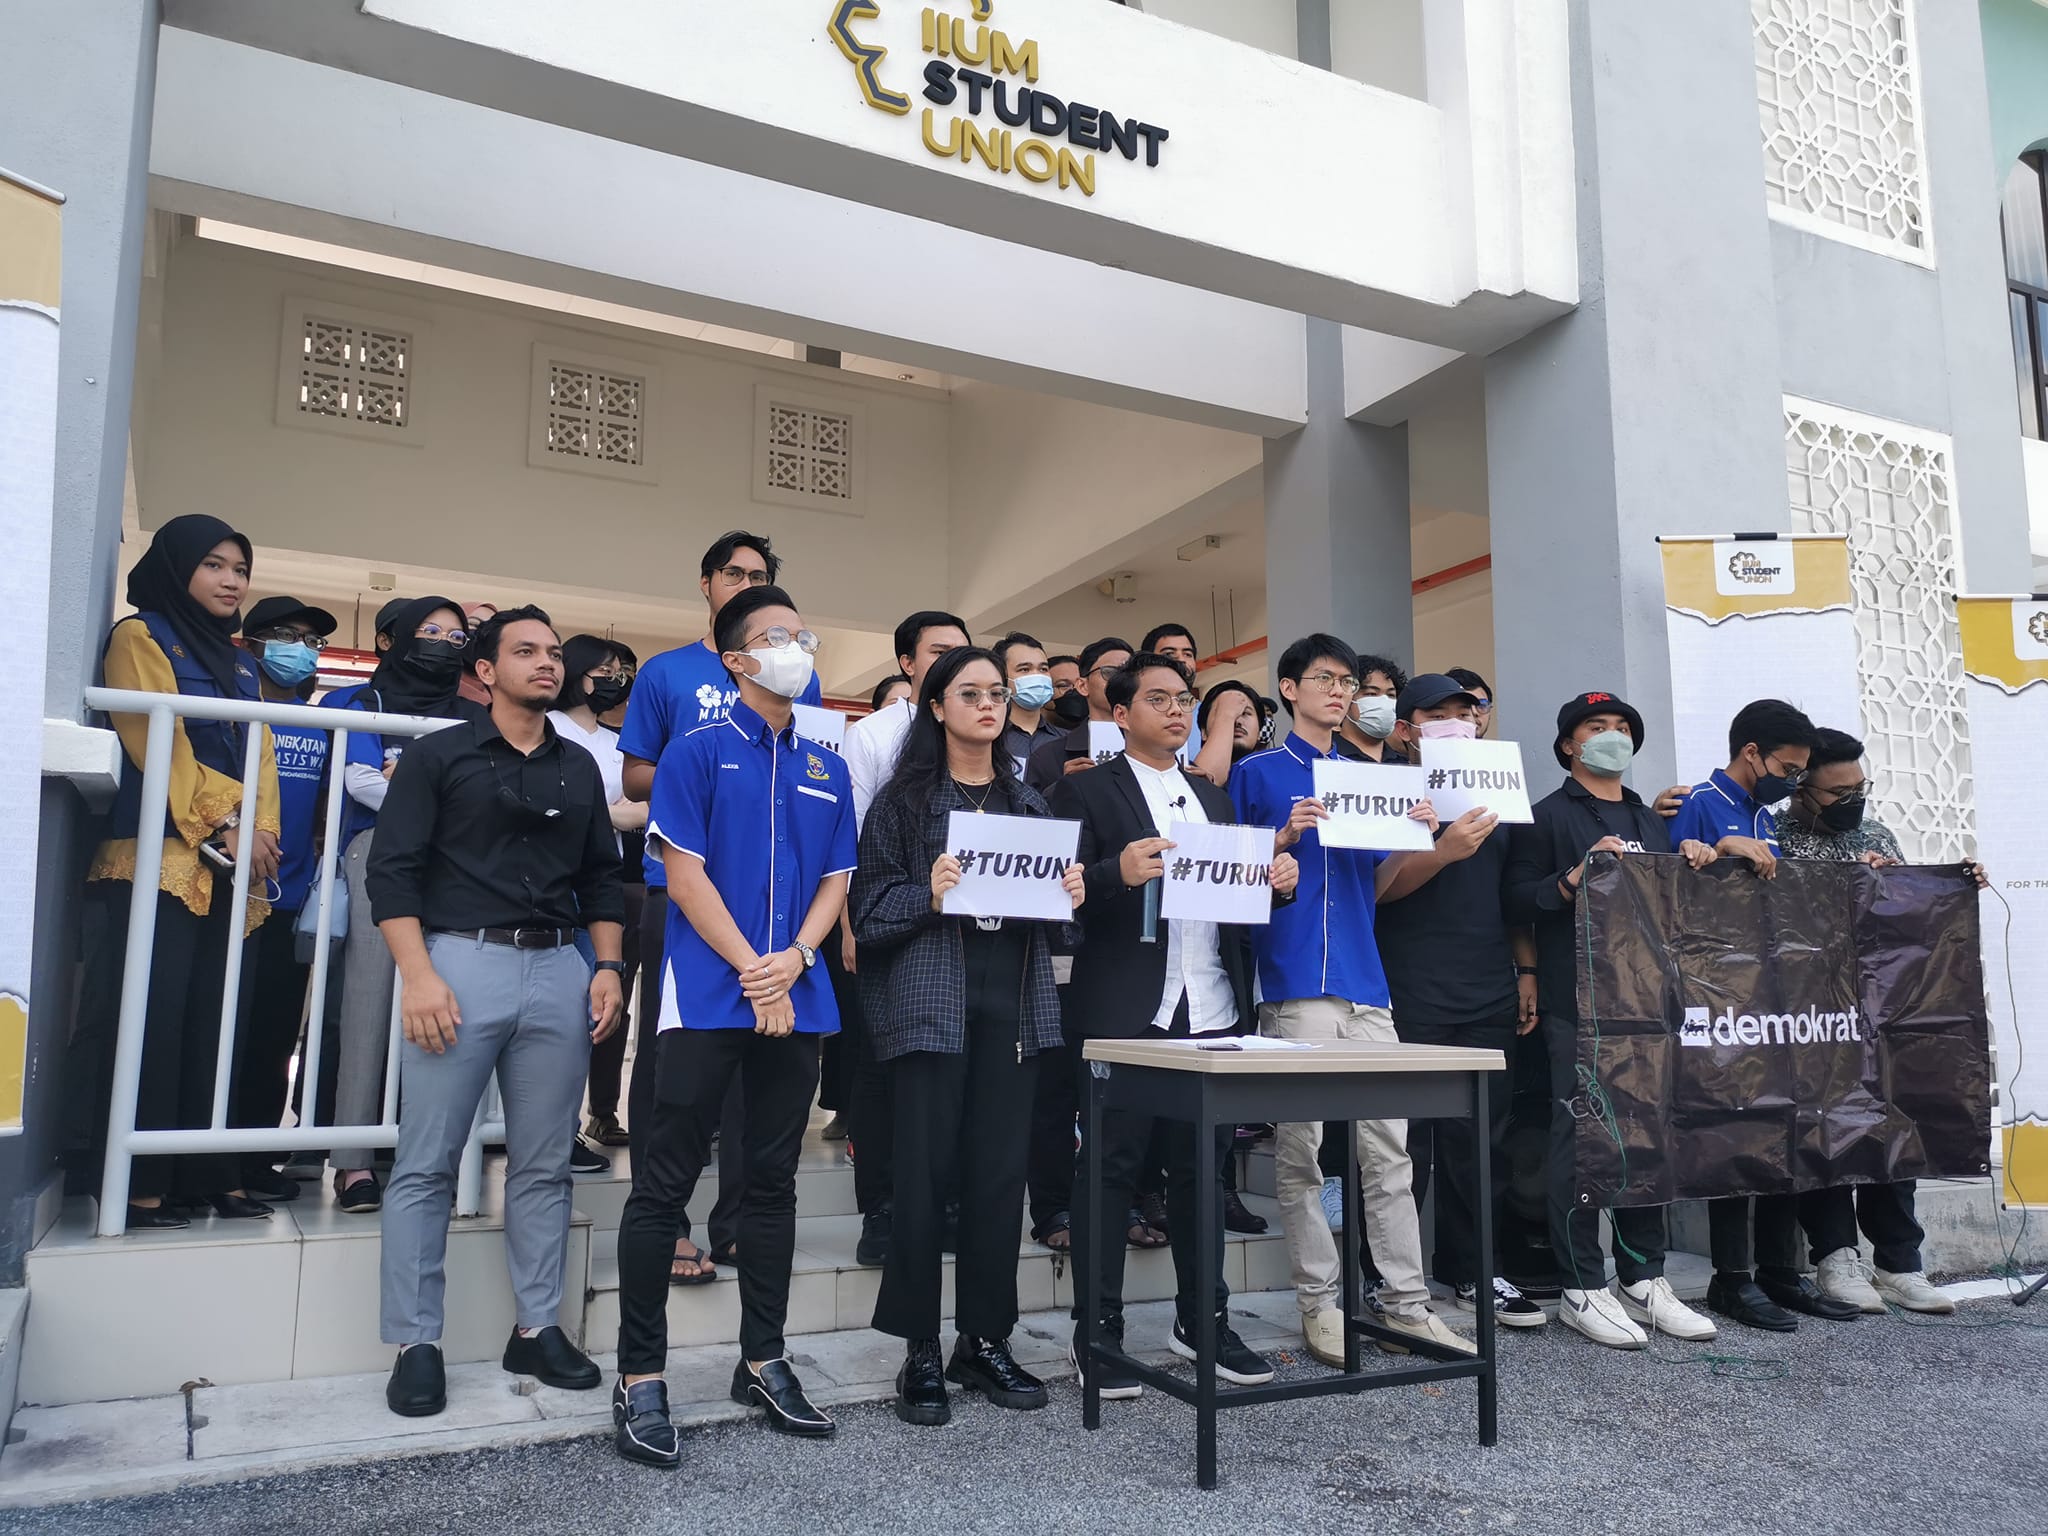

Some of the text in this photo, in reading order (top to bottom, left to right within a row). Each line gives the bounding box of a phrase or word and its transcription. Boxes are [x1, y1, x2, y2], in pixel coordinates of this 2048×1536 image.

[921, 8, 1039, 83] IIUM
[922, 60, 1170, 167] STUDENT
[921, 107, 1096, 197] UNION
[1742, 567, 1781, 576] STUDENT
[1743, 576, 1772, 584] UNION
[1427, 768, 1521, 791] #TURUN
[1321, 791, 1421, 817] #TURUN
[955, 849, 1072, 881] #TURUN
[1170, 856, 1270, 887] #TURUN
[2006, 880, 2031, 889] FOR
[1712, 1003, 1862, 1047] demokrat
